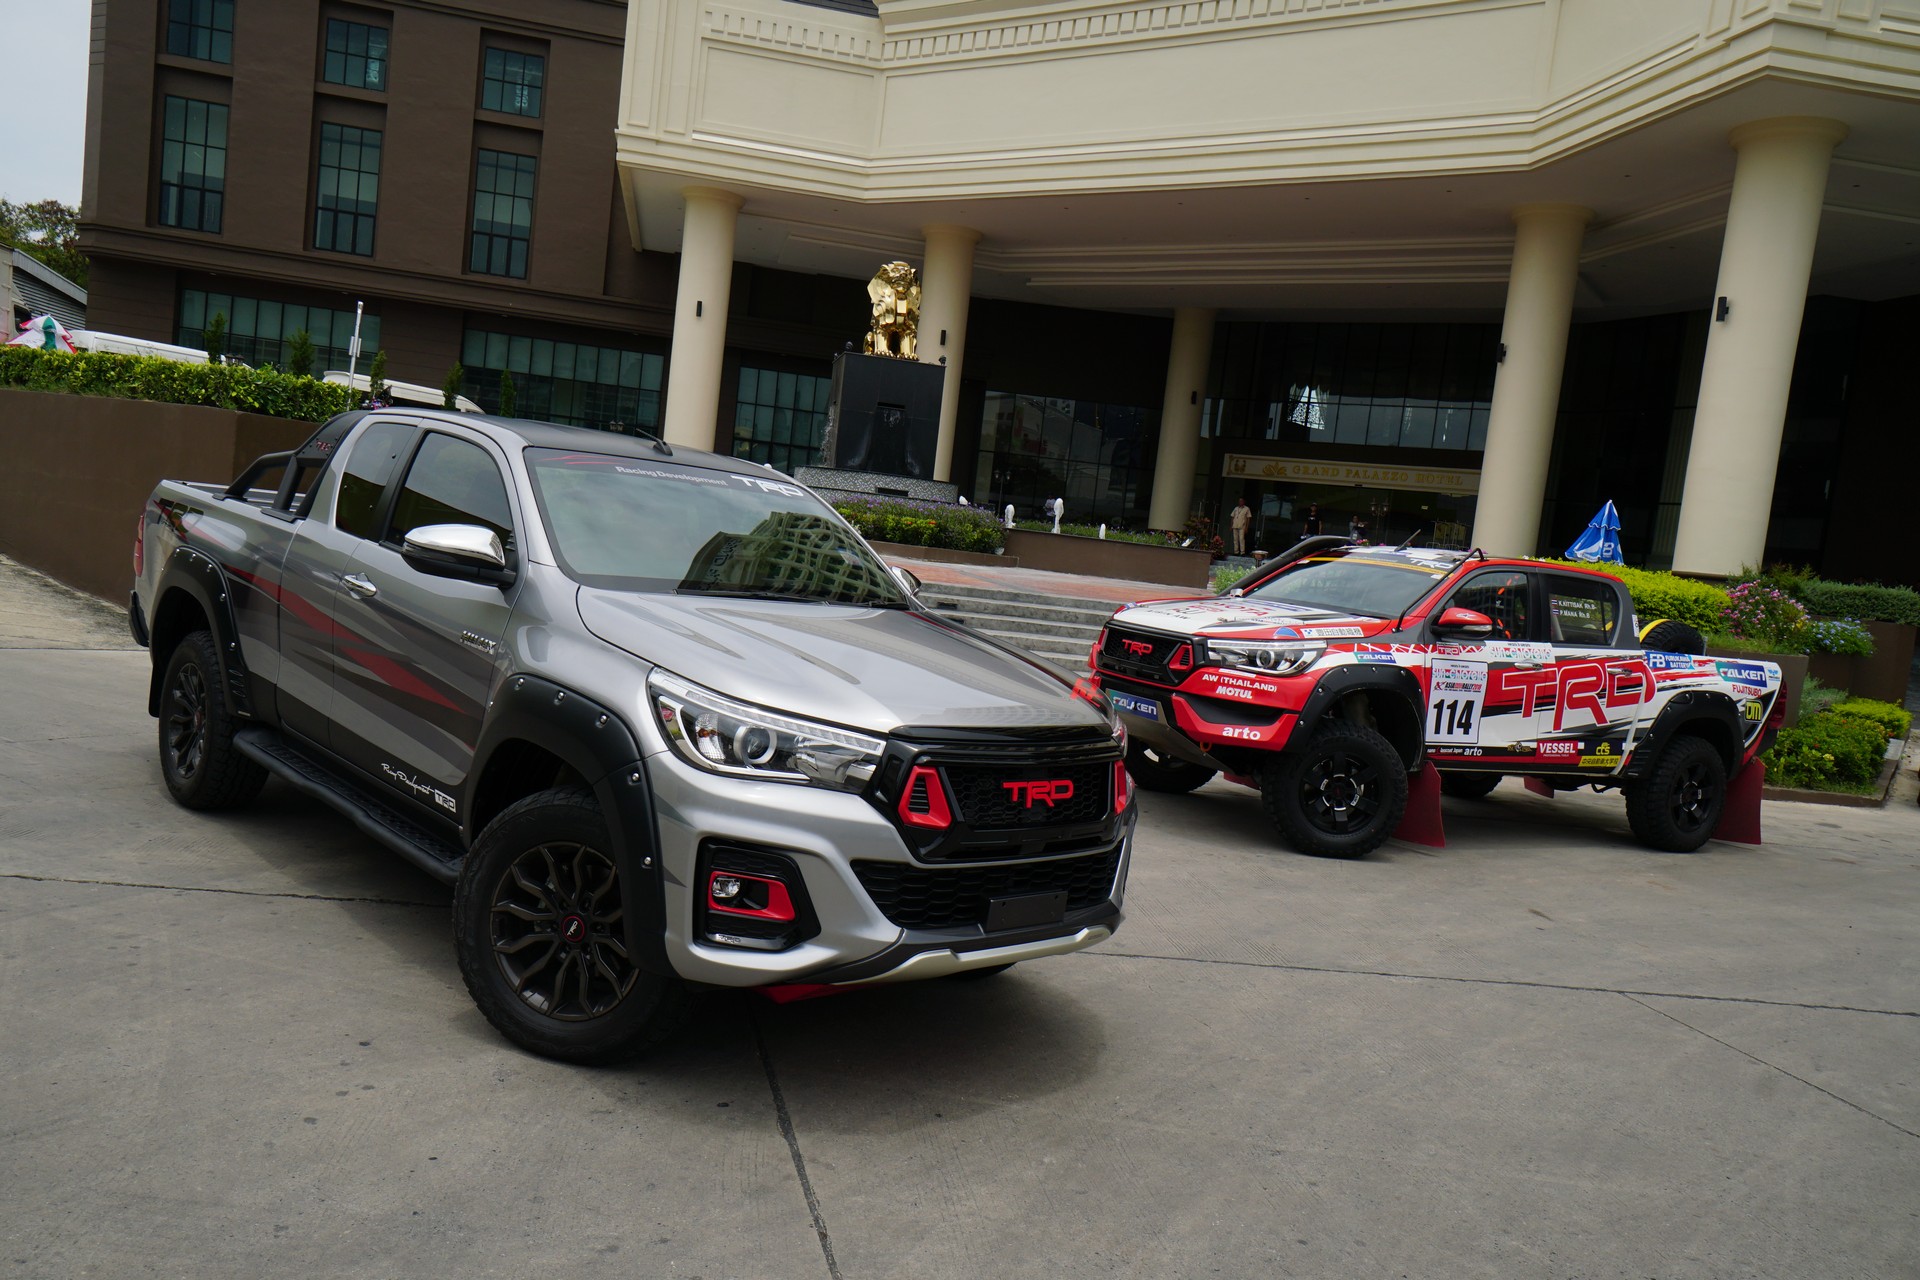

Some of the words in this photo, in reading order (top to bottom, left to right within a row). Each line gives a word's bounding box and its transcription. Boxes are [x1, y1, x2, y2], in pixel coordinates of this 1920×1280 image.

[1293, 465, 1340, 477] GRAND
[1344, 468, 1408, 482] PALAZZO
[1415, 473, 1463, 486] HOTEL
[730, 474, 804, 497] TRD
[1409, 558, 1454, 569] TRD
[1122, 639, 1153, 655] TRD
[1649, 654, 1666, 668] FB
[1720, 667, 1766, 681] FALKEN
[1202, 674, 1219, 683] AW
[1220, 676, 1278, 693] (THAILAND)
[1731, 684, 1762, 698] FUJITSUBO
[1216, 685, 1253, 700] MOTUL
[1502, 659, 1657, 732] TRD
[1113, 696, 1157, 715] FALKEN
[1433, 699, 1475, 735] 114
[1222, 726, 1261, 741] arto
[1464, 747, 1483, 756] arto
[1539, 742, 1576, 754] VESSEL
[1003, 778, 1074, 809] TRD
